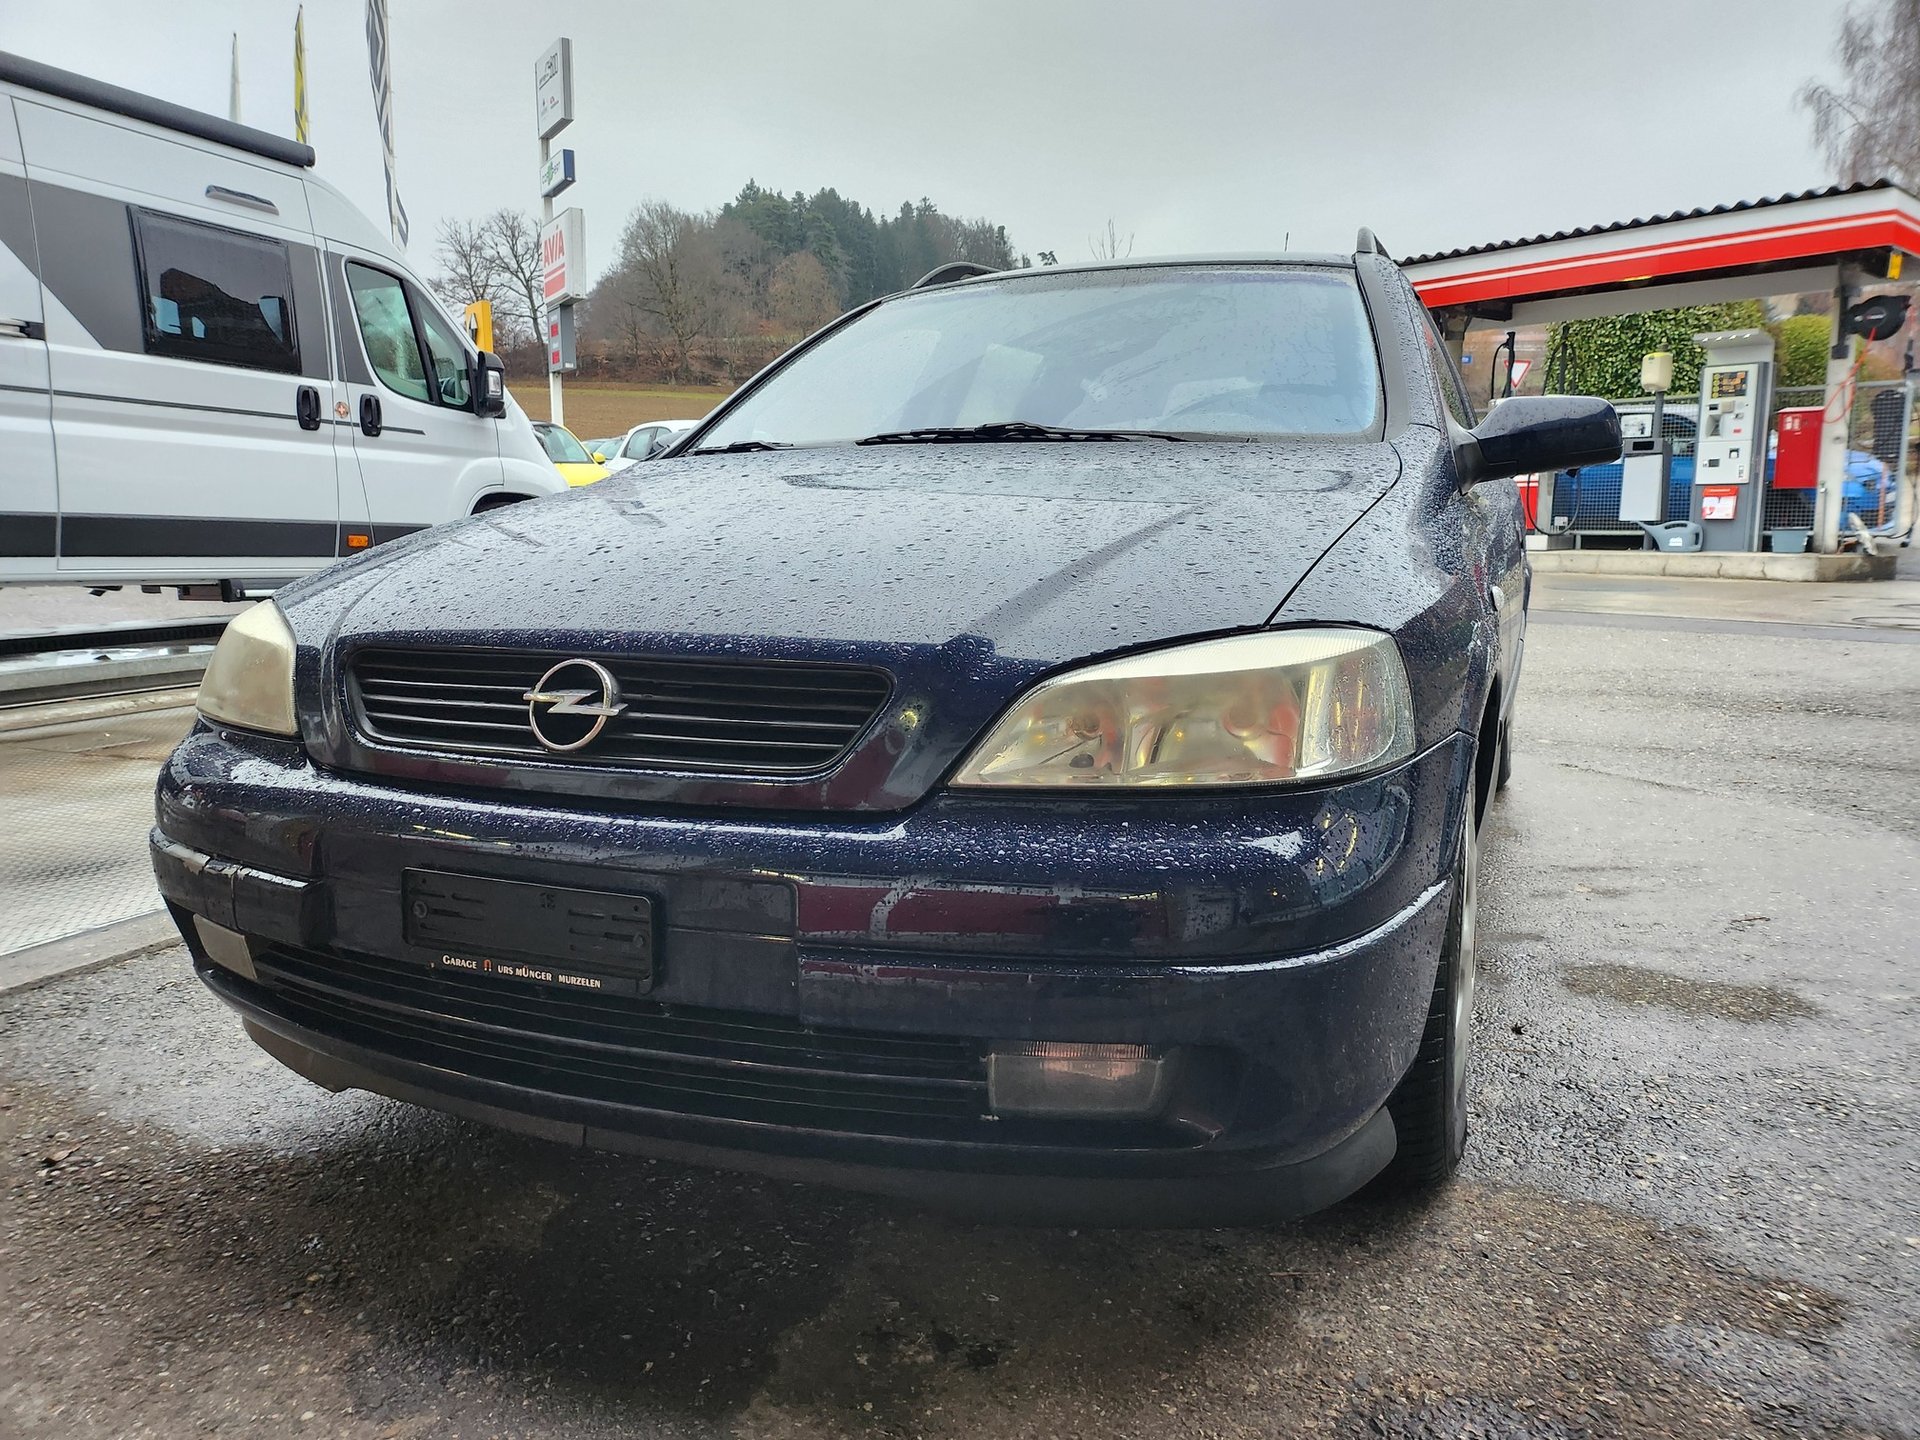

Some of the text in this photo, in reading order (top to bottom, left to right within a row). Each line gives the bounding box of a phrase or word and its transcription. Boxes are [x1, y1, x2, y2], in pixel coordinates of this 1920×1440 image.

[442, 954, 478, 969] GARAGE
[497, 964, 514, 975] URS
[558, 974, 601, 989] MURZELEN
